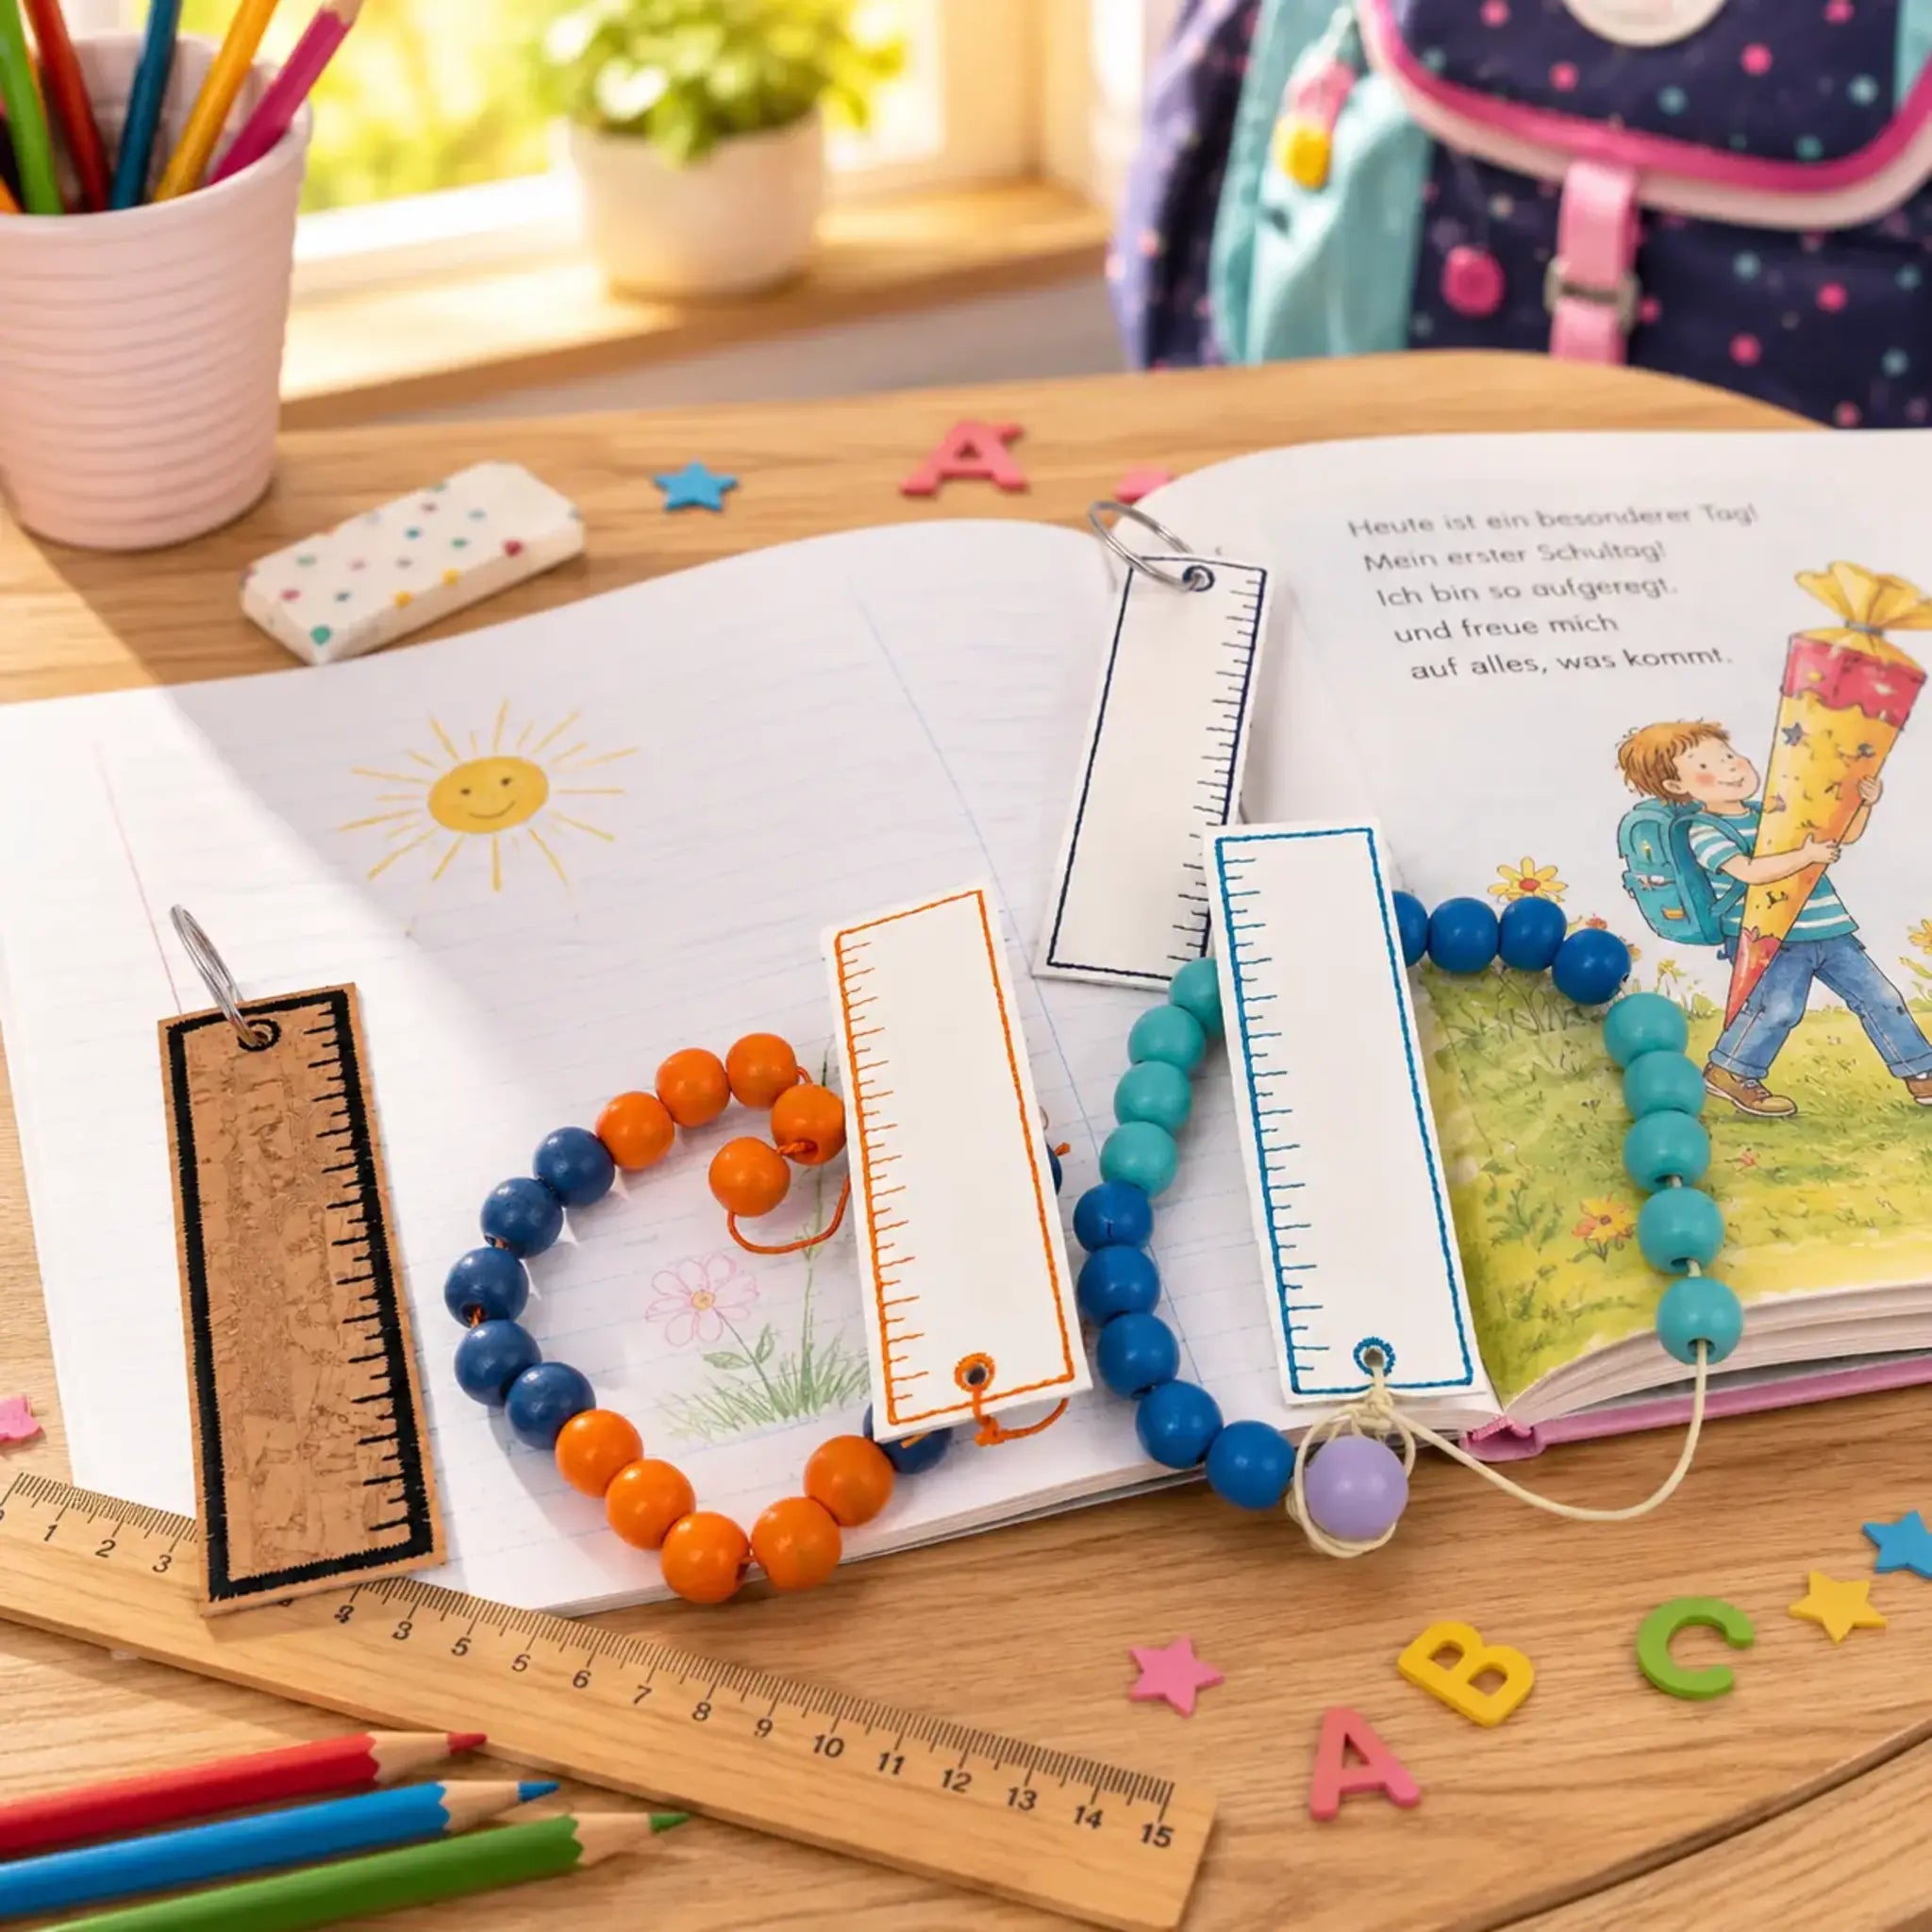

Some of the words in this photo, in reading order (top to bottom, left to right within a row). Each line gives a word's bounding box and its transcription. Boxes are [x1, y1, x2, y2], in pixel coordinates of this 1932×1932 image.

[1347, 517, 1434, 538] Heute
[1443, 514, 1476, 530] ist
[1487, 511, 1530, 529] ein
[1535, 507, 1690, 527] besonderer
[1699, 503, 1757, 527] Tag!
[1363, 550, 1438, 572] Mein
[1447, 548, 1526, 564] erster
[1536, 541, 1666, 563] Schultag!
[1376, 586, 1423, 607] Ich
[1430, 582, 1479, 602] bin
[1488, 584, 1522, 600] so
[1531, 577, 1677, 601] aufgeregt.
[1393, 620, 1452, 643] und
[1461, 618, 1539, 638] freue
[1548, 613, 1620, 633] mich
[1410, 657, 1458, 680] auf
[1471, 654, 1548, 675] alles,
[1557, 655, 1616, 670] was
[1622, 648, 1734, 668] kommt.
[43, 1524, 58, 1542] 1
[94, 1539, 116, 1558] 2
[152, 1554, 172, 1574] 3
[391, 1621, 413, 1641] 3
[451, 1637, 472, 1657] 5
[572, 1669, 591, 1690] 6
[633, 1685, 652, 1705] 7
[691, 1701, 711, 1723] 8
[754, 1718, 774, 1739] 9
[812, 1734, 845, 1759] 10
[876, 1751, 906, 1776] 11
[941, 1768, 973, 1793] 12
[1006, 1786, 1038, 1812] 13
[1073, 1804, 1104, 1830] 14
[1140, 1823, 1174, 1849] 15
[1308, 1706, 1422, 1822] A
[1397, 1620, 1535, 1728] B
[1636, 1595, 1755, 1702] C
